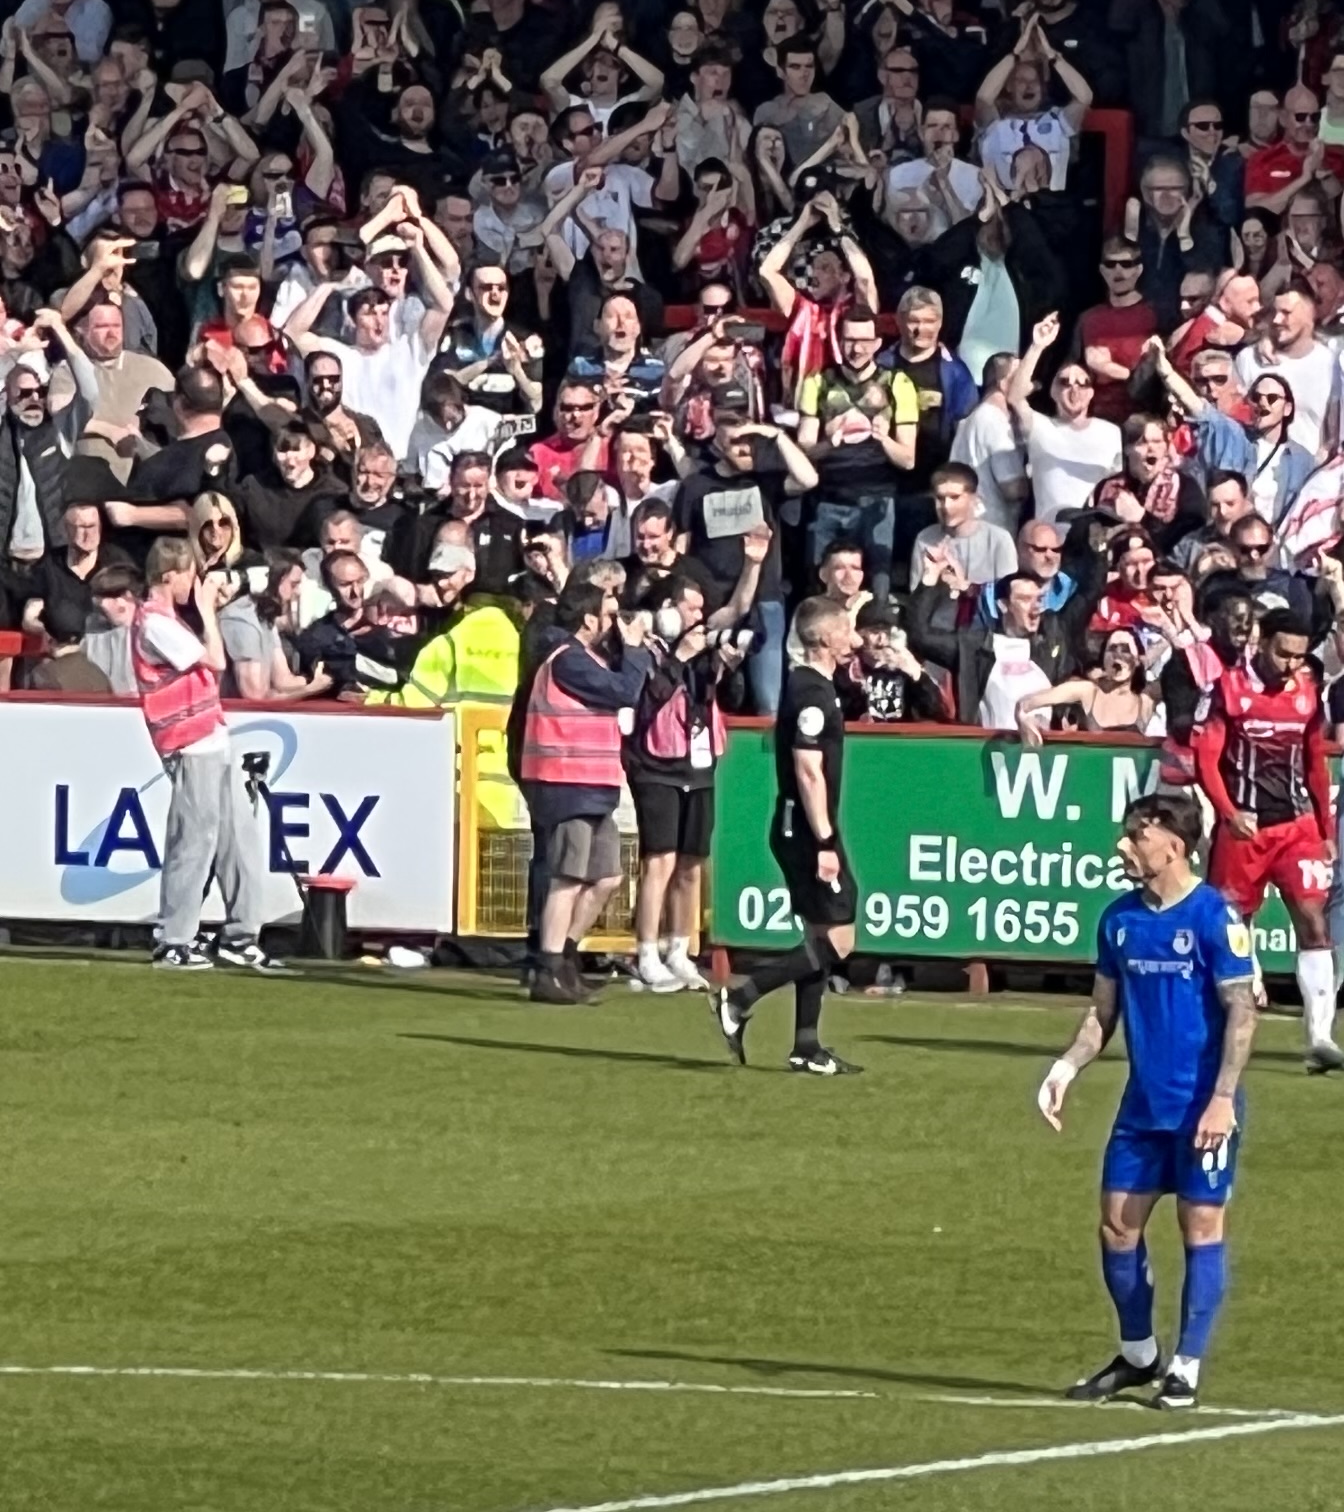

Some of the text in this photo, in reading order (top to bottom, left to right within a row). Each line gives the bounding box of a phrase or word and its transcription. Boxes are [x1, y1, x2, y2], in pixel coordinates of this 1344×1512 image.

[991, 750, 1082, 821] W.
[54, 784, 381, 878] LAEX
[909, 833, 1138, 892] Electrica
[865, 891, 950, 940] 959
[968, 897, 1080, 946] 1655
